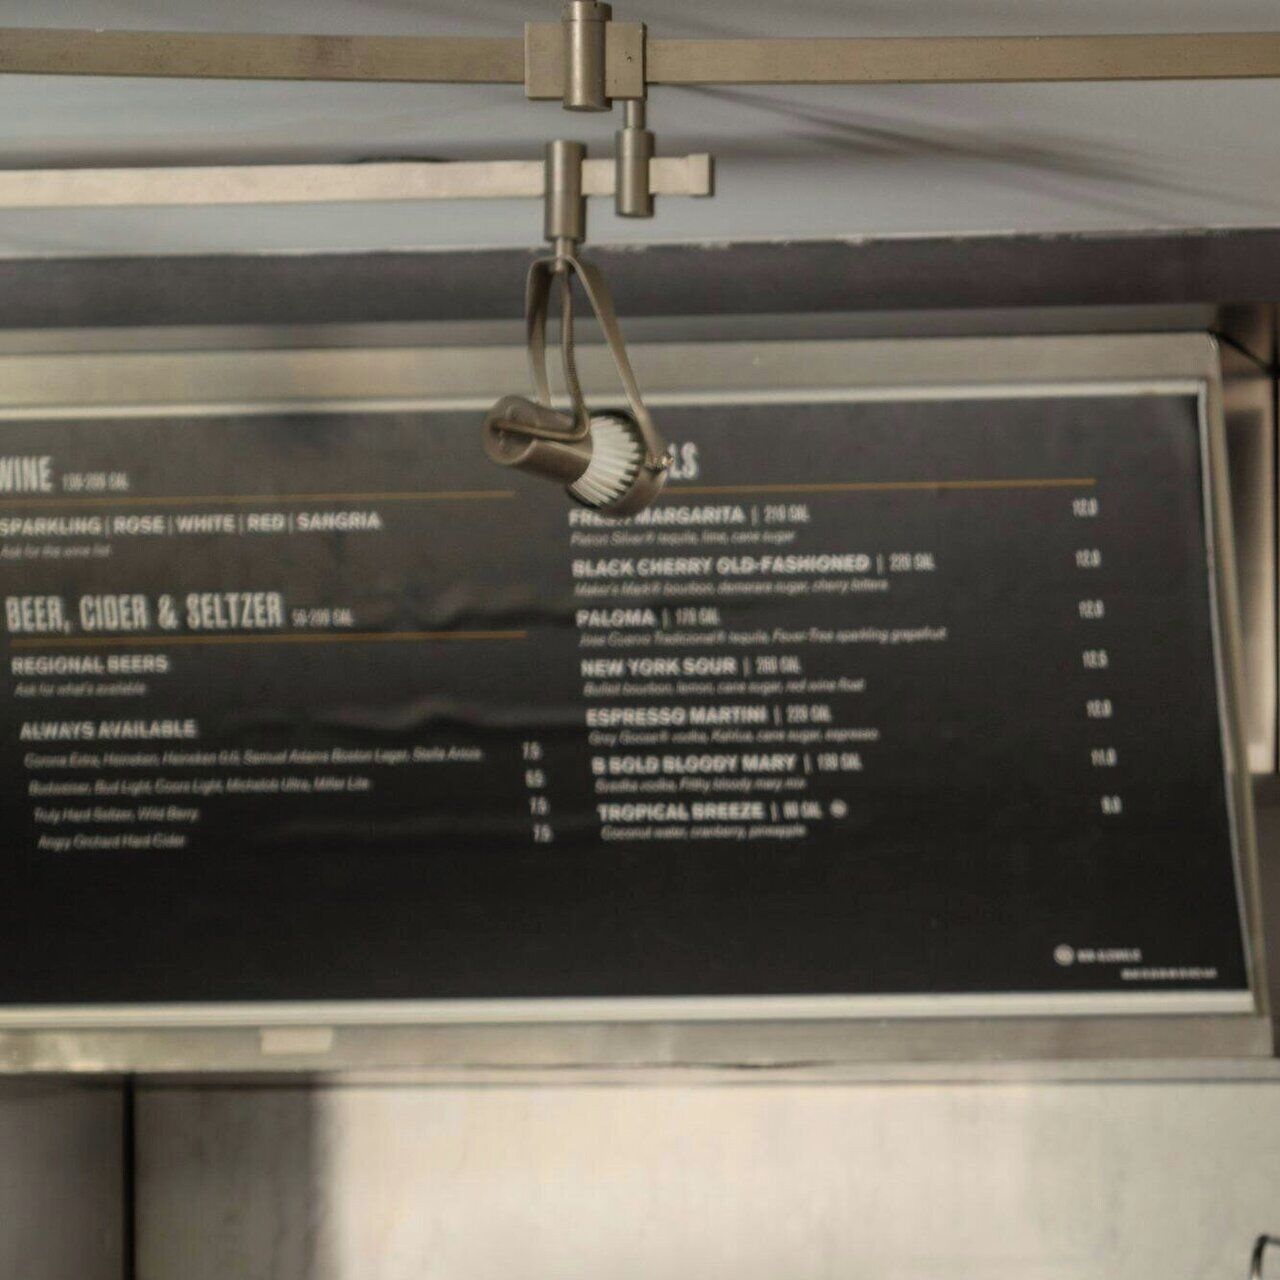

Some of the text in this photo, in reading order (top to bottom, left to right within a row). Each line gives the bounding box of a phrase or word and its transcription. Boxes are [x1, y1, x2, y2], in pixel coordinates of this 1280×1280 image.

[0, 511, 382, 536] SPARKLING ROSE WHITE RED SANGRIA
[635, 506, 744, 525] MARGARITA
[572, 558, 630, 578] BLACK
[637, 556, 712, 576] CHERRY
[716, 553, 870, 574] OLD-FASHIONED
[6, 595, 71, 634] BEER,
[80, 594, 148, 631] CIDER
[158, 594, 179, 630] &
[187, 592, 283, 629] SELTZER
[576, 609, 655, 627] PALOMA
[11, 655, 168, 675] REGIONAL BEERS
[581, 659, 625, 677] NEW
[628, 658, 680, 676] YORK
[682, 657, 737, 675] SOUR
[586, 707, 686, 727] ESPRESSO
[689, 705, 767, 725] MARTINI
[20, 719, 197, 740] ALWAYS AVAILABLE
[609, 756, 659, 775] BOLD
[662, 755, 738, 774] BLOODY
[742, 753, 797, 773] MARY
[597, 804, 689, 822] TROPICAL
[692, 801, 765, 820] BREEZE
